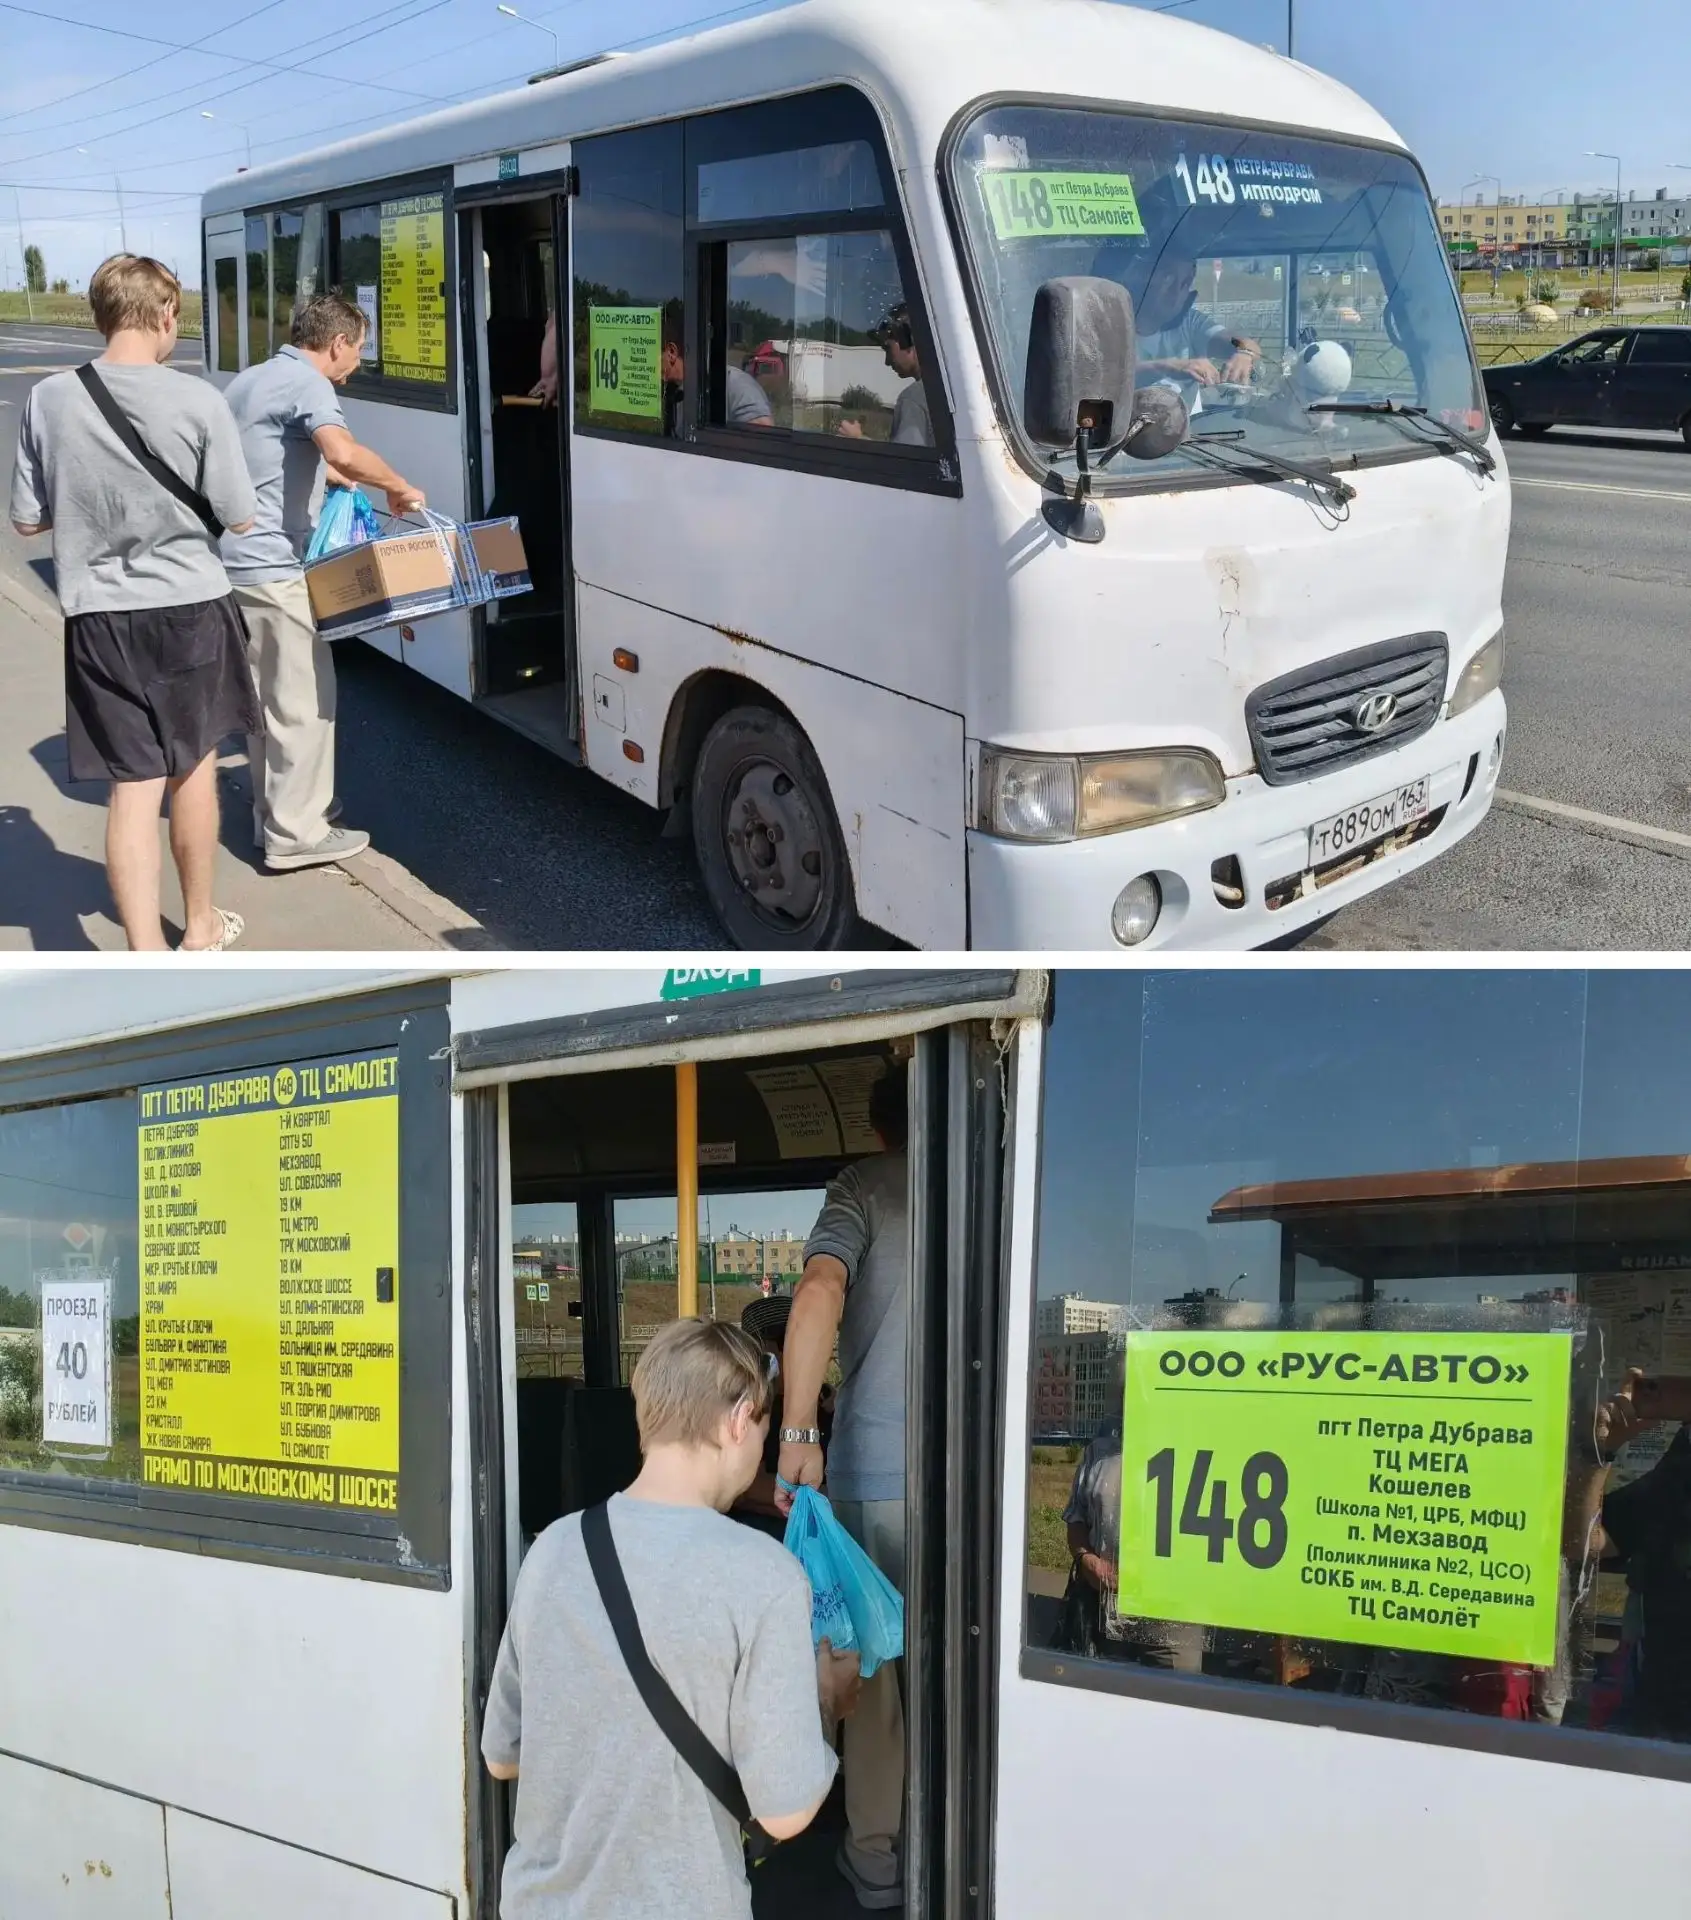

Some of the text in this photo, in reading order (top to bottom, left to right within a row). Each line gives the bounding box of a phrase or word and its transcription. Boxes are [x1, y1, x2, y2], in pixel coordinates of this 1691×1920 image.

[500, 159, 516, 174] ВХОД
[1175, 153, 1236, 204] 148
[1234, 158, 1315, 179] ПЕТРА-ДУБРАВА
[992, 178, 1053, 230] 148
[1050, 182, 1129, 198] пгт Петра Дубрава
[1240, 184, 1322, 204] ИППОДРОМ
[1056, 206, 1135, 228] ТЦ Самолёт
[596, 314, 610, 324] ООО
[594, 348, 618, 390] 148
[380, 539, 437, 557] ПОЧТА РОССИИ
[1400, 780, 1425, 811] 163
[1403, 808, 1416, 820] RUS
[142, 1057, 398, 1118] ПГТ ПЕТРА ДУБРАВА 148 ТЦ САМОЛЕТ
[46, 1298, 98, 1320] ПРОЕЗД
[56, 1342, 88, 1380] 40
[1159, 1350, 1529, 1384] ООО «РУС-АВТО»
[48, 1400, 97, 1424] РУБЛЕЙ
[1318, 1418, 1533, 1447] пгт Петра Дубрава
[1373, 1450, 1469, 1474] ТЦ МЕГА
[144, 1456, 396, 1510] ПРЯМО ПО МОСКОВСКОМУ ШОССЕ
[1369, 1474, 1471, 1499] Кошелев
[1146, 1447, 1288, 1570] 148
[1316, 1496, 1526, 1531] (Школа №1, ЦРБ, МФЦ)
[1348, 1523, 1488, 1554] п. Мехзавод
[1306, 1544, 1532, 1584] (Поликлиника №2, ЦСО)
[1300, 1566, 1535, 1607] СОКБ им. В.Д. Середавина
[1348, 1596, 1480, 1628] ТЦ Самолёт
